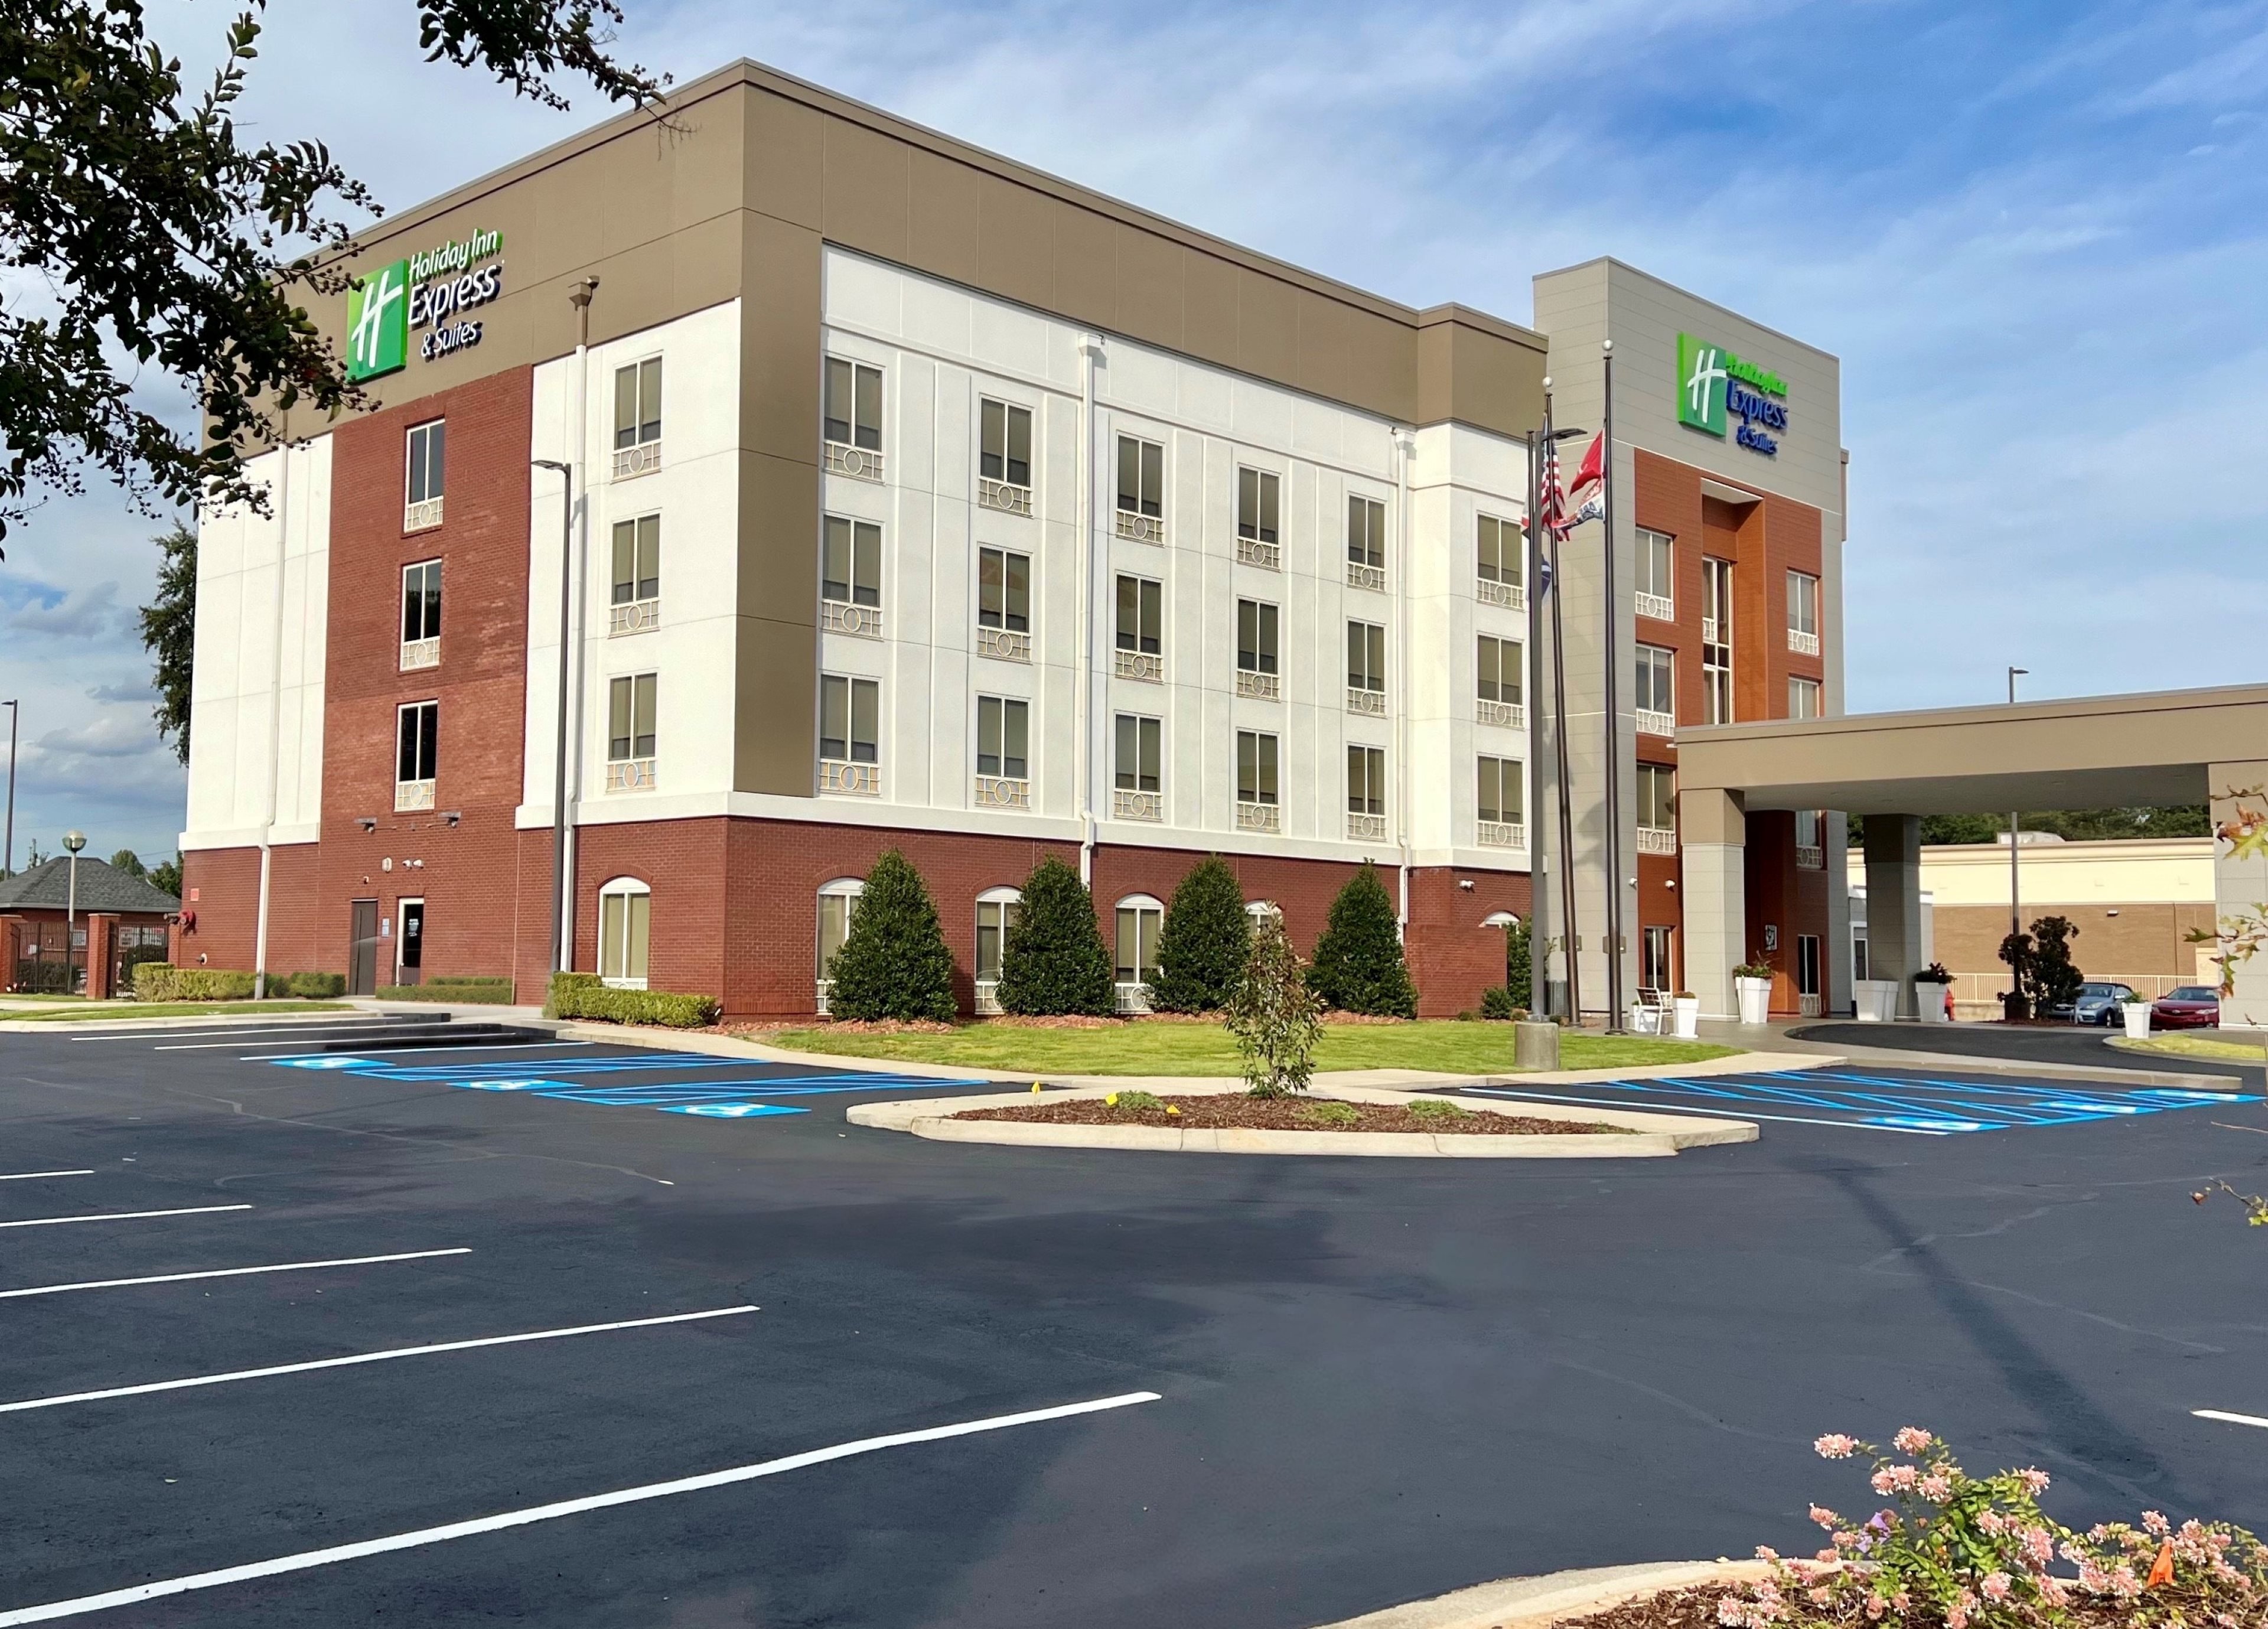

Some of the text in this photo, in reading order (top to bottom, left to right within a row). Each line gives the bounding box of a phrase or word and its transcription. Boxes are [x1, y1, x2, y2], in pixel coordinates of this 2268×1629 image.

[409, 228, 502, 282] Holiday Inn
[408, 265, 501, 327] Express
[421, 321, 480, 357] & Suites
[1726, 380, 1788, 428] Express
